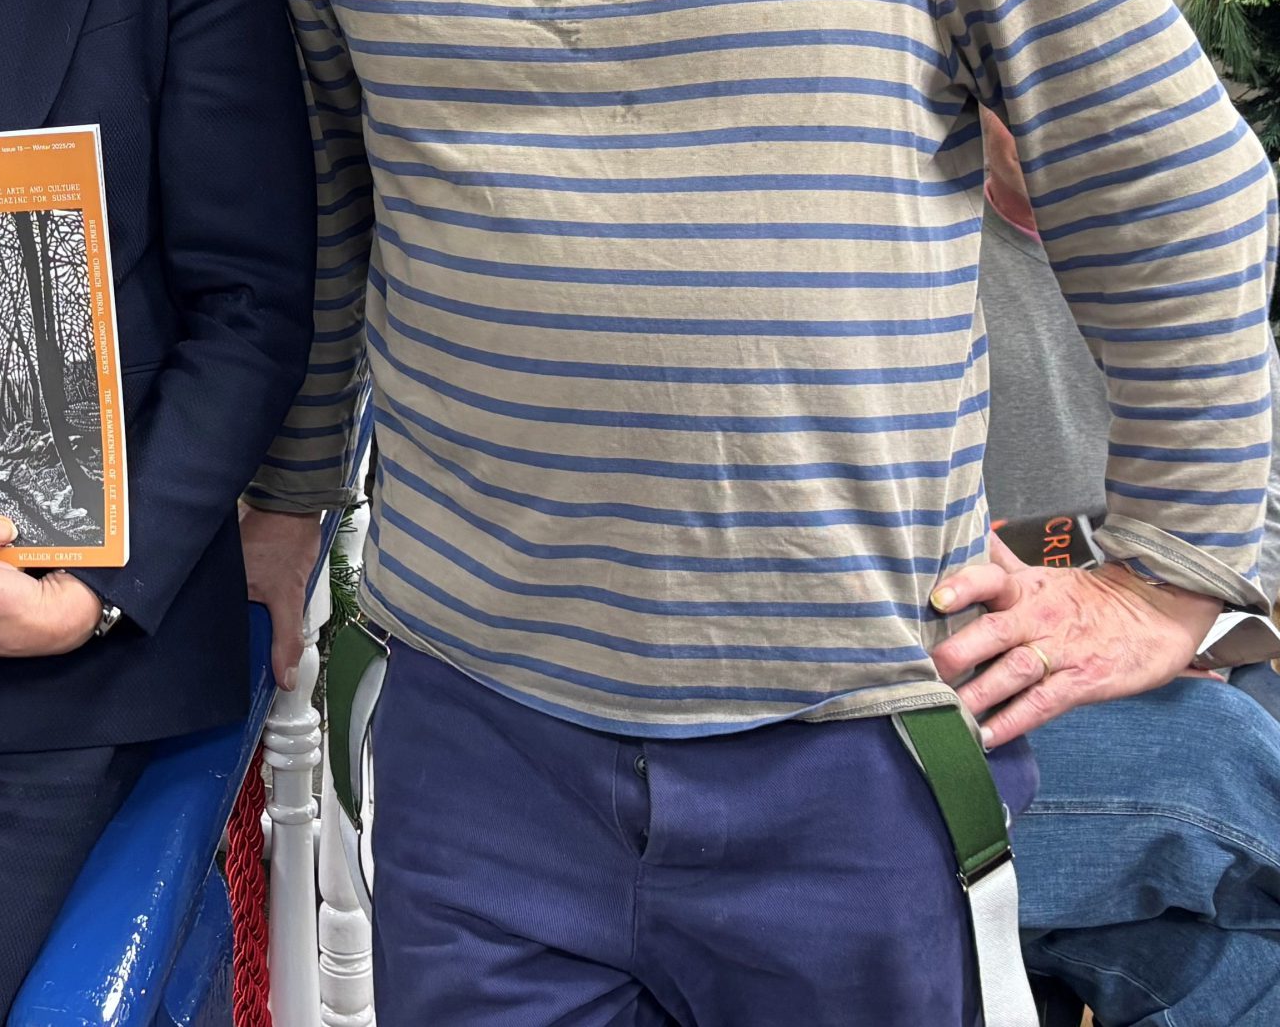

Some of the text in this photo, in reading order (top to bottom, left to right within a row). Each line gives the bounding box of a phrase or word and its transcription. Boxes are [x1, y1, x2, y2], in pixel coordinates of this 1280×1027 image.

[6, 186, 25, 195] ARTS
[29, 185, 44, 193] AND
[47, 183, 81, 193] CULTURE
[32, 194, 47, 203] FOR
[51, 192, 82, 202] SUSSEX
[89, 219, 110, 375] BERWICK CHURCH MURAL CONTROVERSY
[104, 389, 118, 536] THE REAWAKENING OF LEE MILLER
[18, 553, 83, 561] WEALDEN CRAFTS
